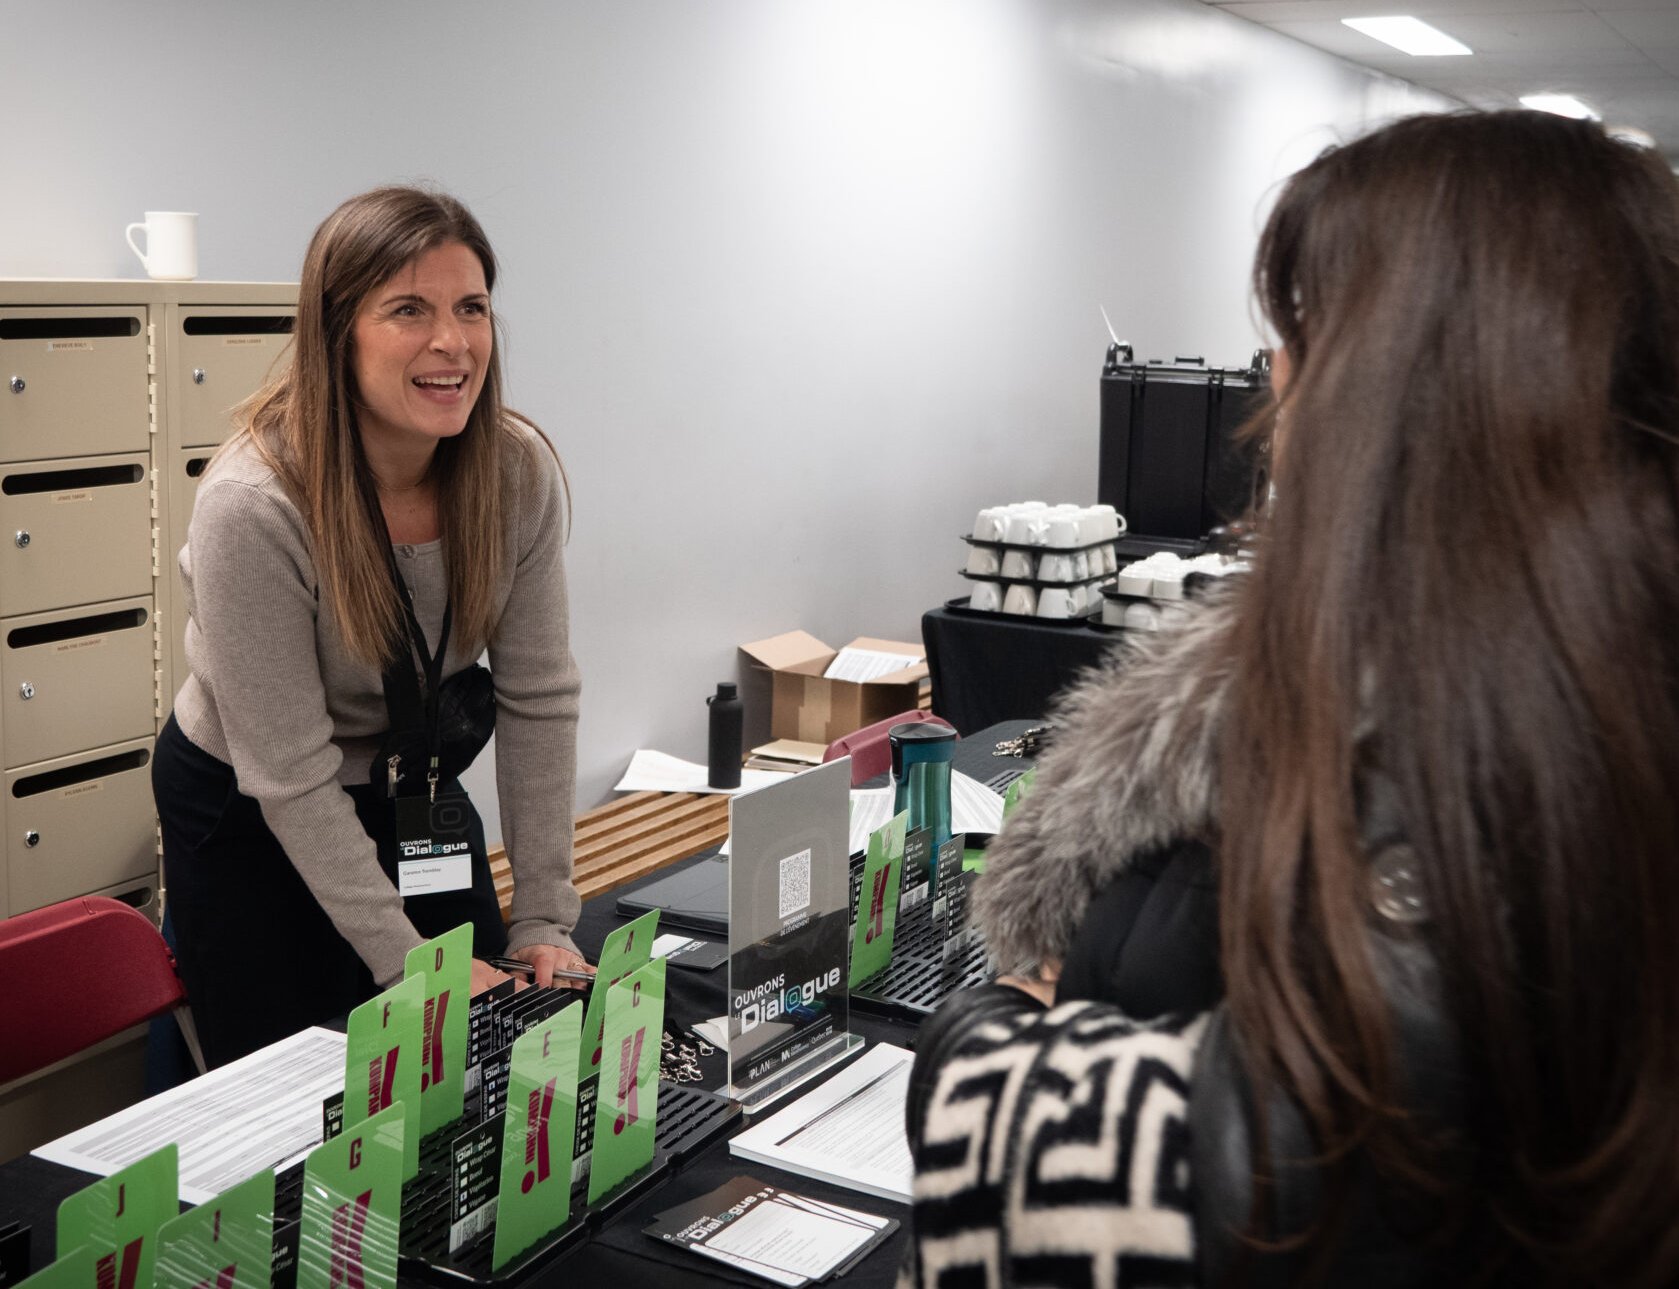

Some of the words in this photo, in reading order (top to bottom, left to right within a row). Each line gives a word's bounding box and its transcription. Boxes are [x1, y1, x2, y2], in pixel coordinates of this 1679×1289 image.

[400, 839, 432, 847] OUVRONS
[404, 842, 469, 856] Dialogue
[624, 930, 634, 954] A
[435, 947, 444, 973] D
[632, 980, 641, 1008] C
[734, 973, 785, 1010] OUVRONS
[741, 967, 841, 1035] Dialogue
[382, 1001, 392, 1029] F
[734, 1013, 741, 1021] LE
[543, 1030, 552, 1058] E
[349, 1137, 362, 1171] G
[457, 1136, 493, 1163] Dialogue
[115, 1183, 125, 1218] J
[213, 1208, 222, 1243] I
[677, 1216, 710, 1238] OUVRONS
[688, 1195, 757, 1240] Dialogue
